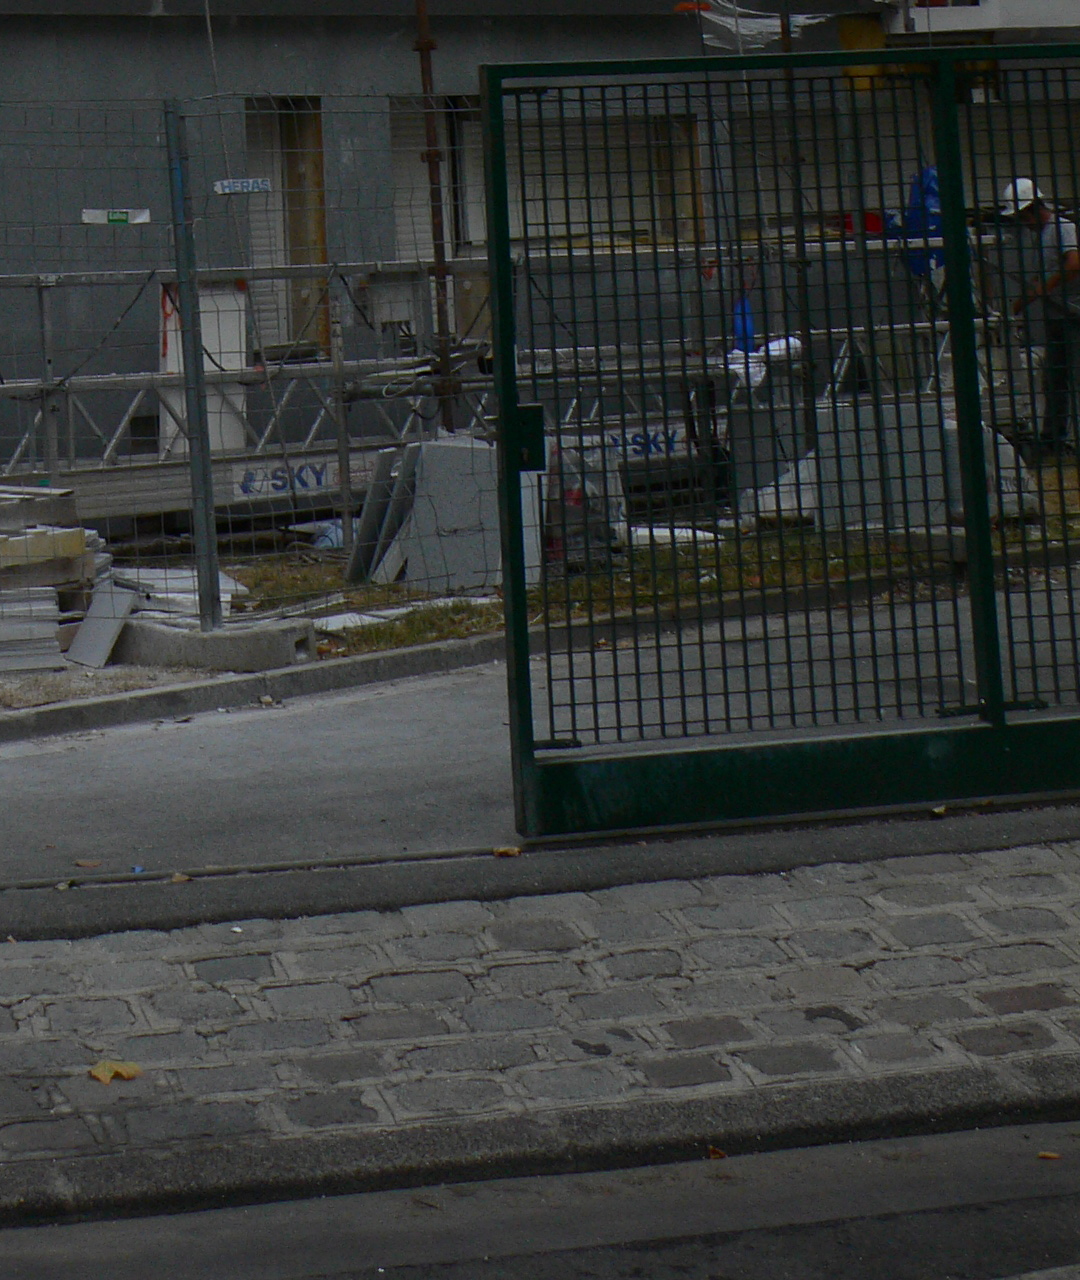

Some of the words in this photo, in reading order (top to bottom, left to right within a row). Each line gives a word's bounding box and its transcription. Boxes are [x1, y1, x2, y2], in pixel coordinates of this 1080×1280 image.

[220, 180, 269, 193] HERAS
[632, 430, 677, 454] SKY
[271, 463, 326, 490] SKY
